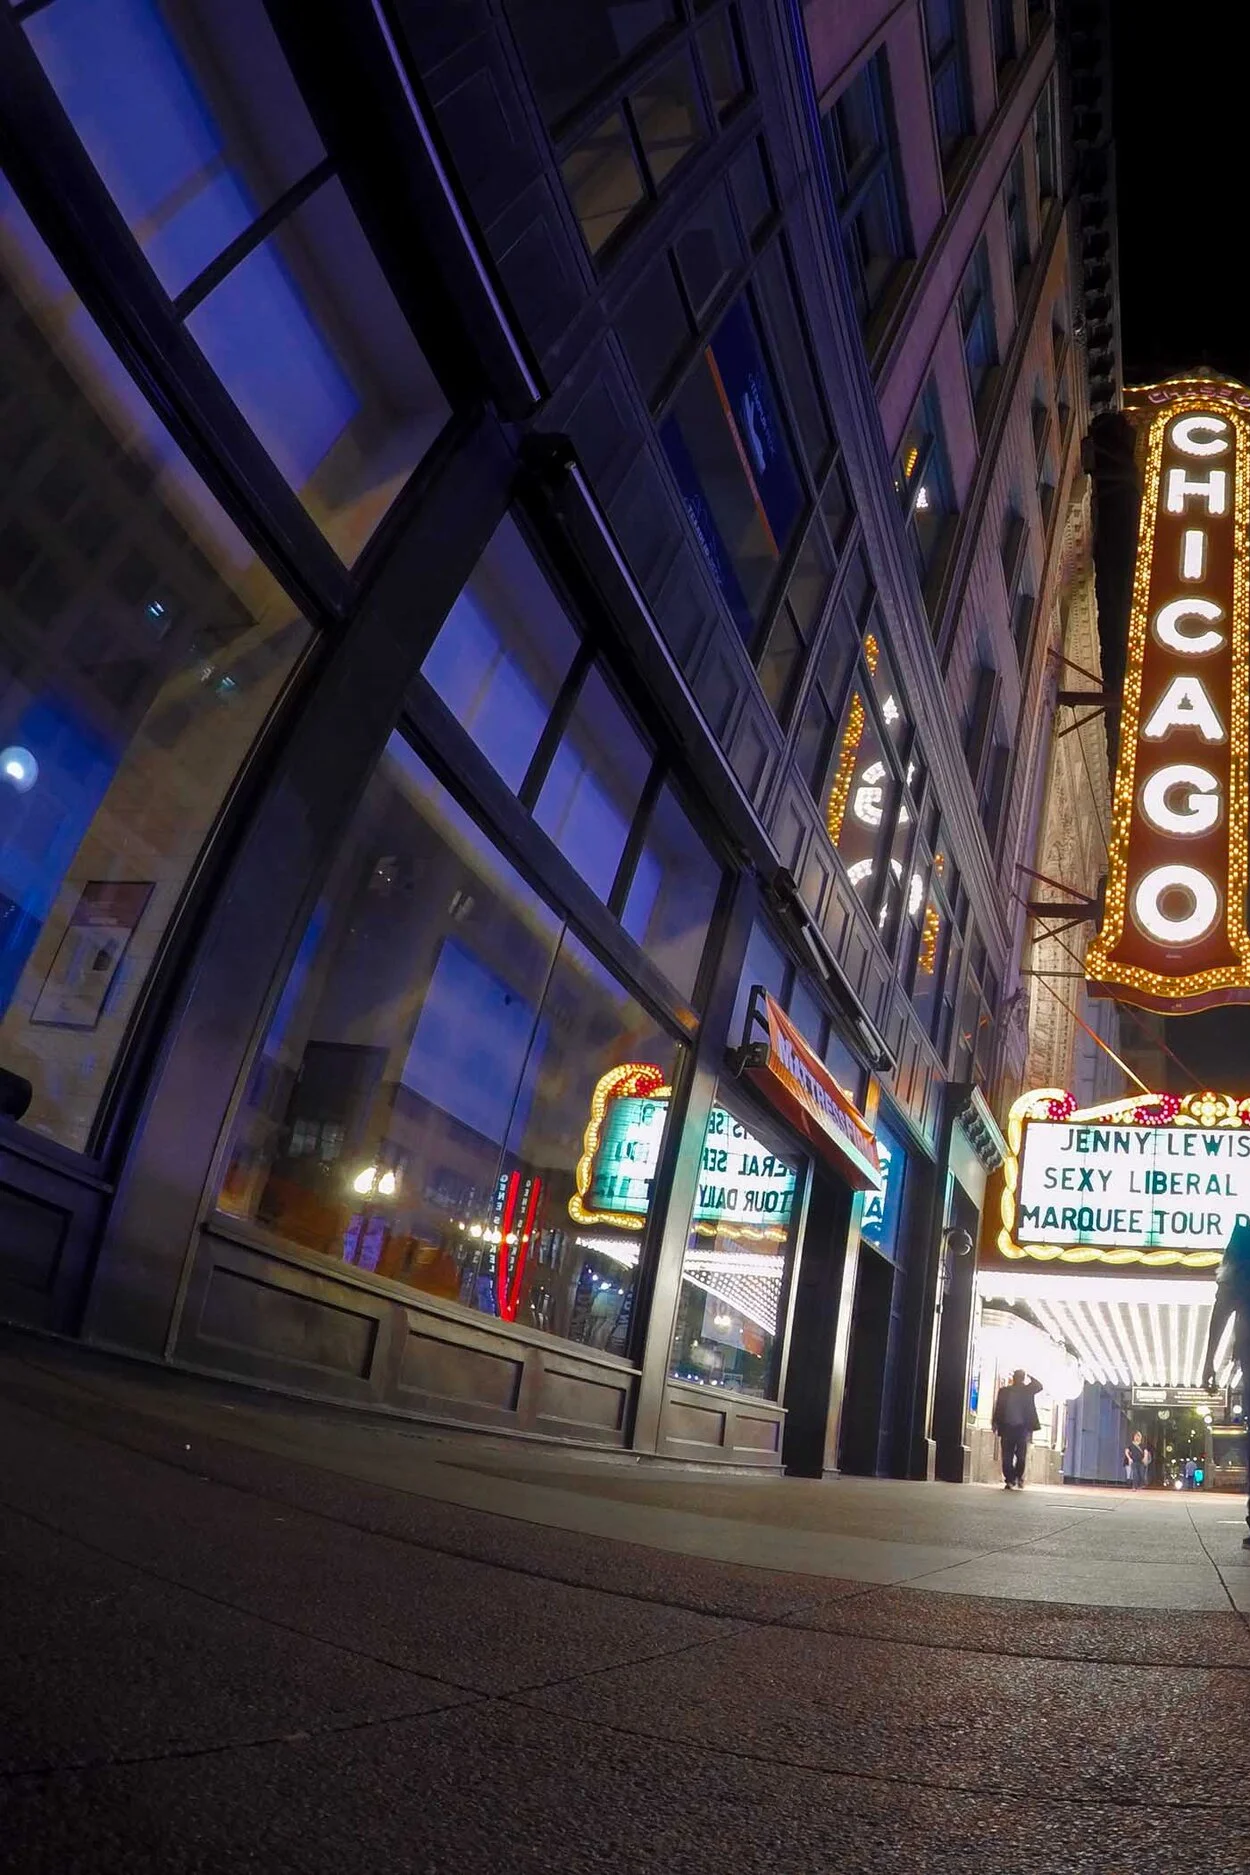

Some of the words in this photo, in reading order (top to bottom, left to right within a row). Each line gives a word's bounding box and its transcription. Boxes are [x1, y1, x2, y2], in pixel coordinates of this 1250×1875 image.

[1134, 415, 1229, 944] CHICAGO
[1060, 1128, 1150, 1154] JENNY
[1167, 1132, 1250, 1158] LEWIS
[1043, 1166, 1112, 1193] SEXY
[1129, 1170, 1238, 1197] LIBERAL
[1018, 1204, 1143, 1233] MARQUEE
[1154, 1209, 1223, 1236] TOUR
